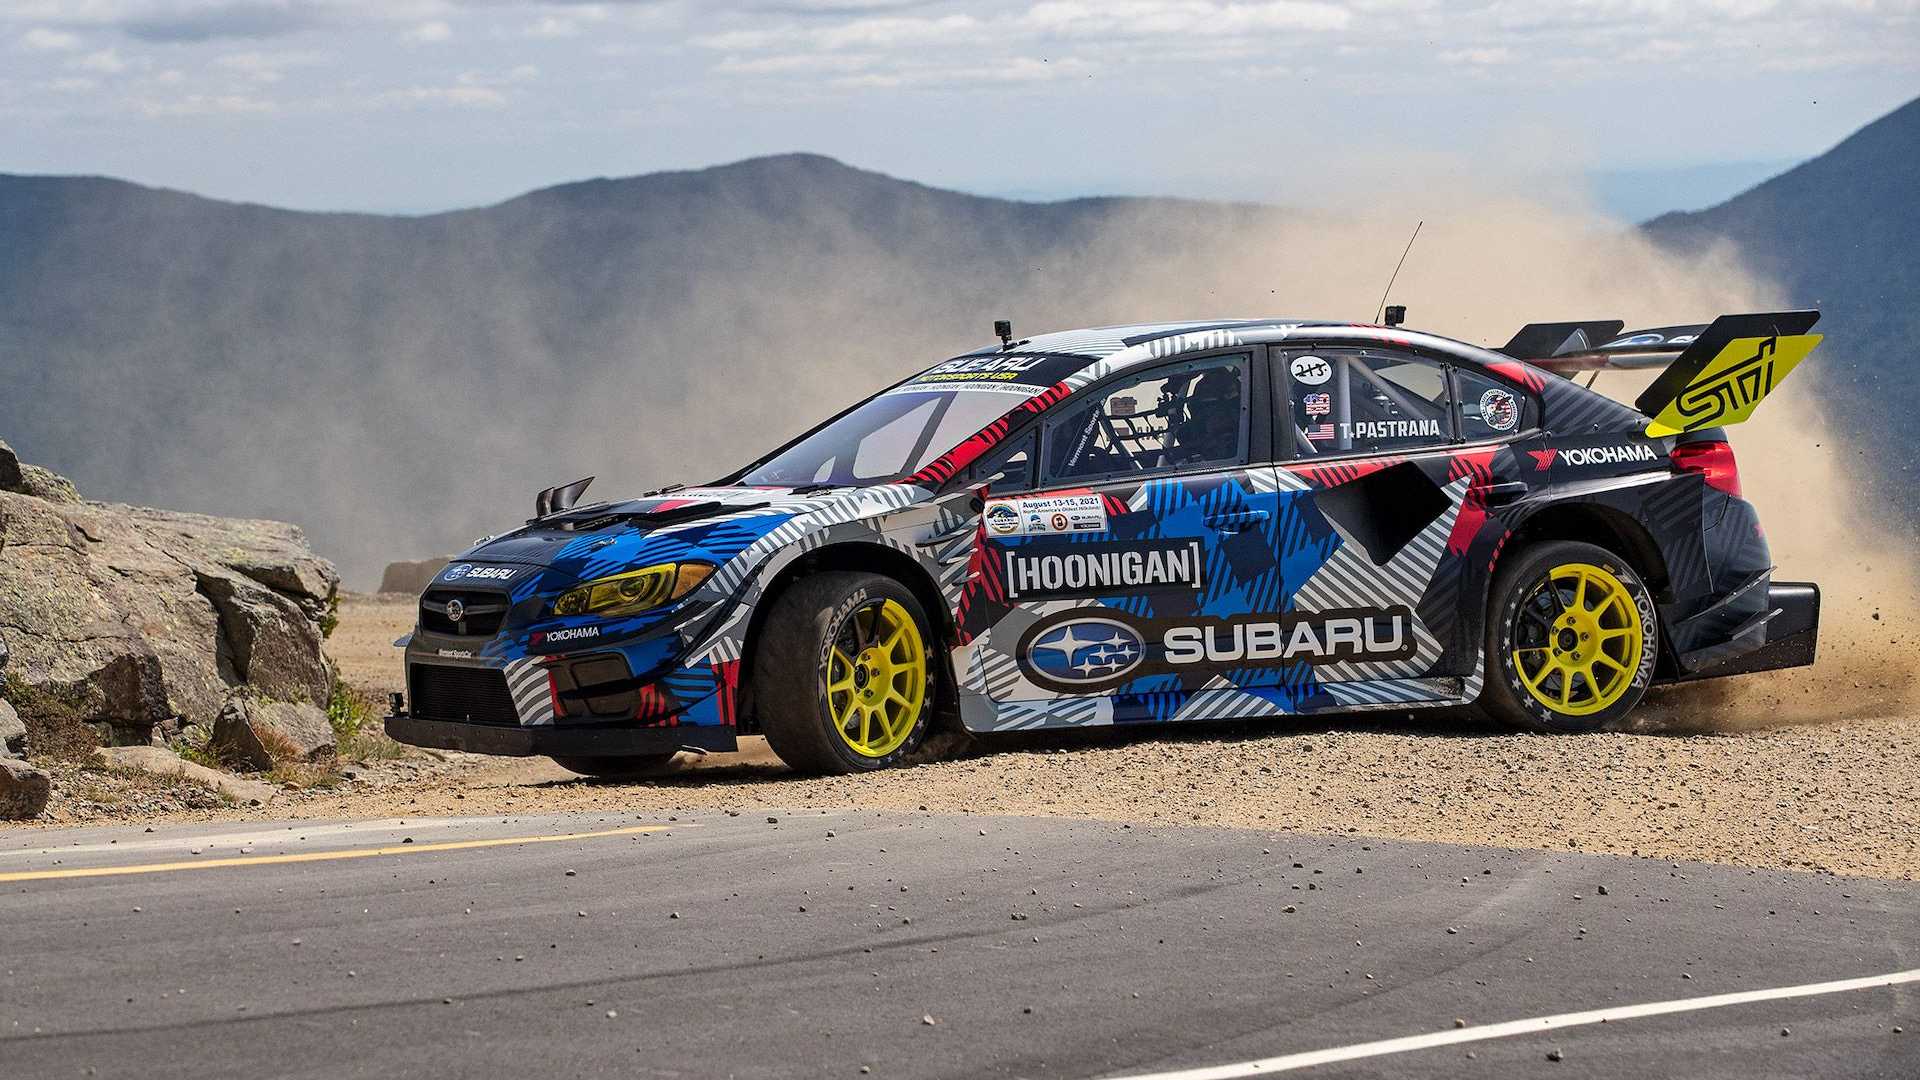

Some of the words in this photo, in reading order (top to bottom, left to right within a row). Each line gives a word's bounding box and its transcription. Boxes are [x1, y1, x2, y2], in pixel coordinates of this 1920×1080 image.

[932, 356, 1047, 374] SUBARU
[1676, 336, 1777, 433] STI
[1067, 434, 1089, 467] Vermont
[1558, 445, 1658, 467] YOKOHAMA
[1022, 498, 1052, 509] August
[1053, 498, 1078, 507] 13-15,
[1079, 497, 1100, 506] 2021
[466, 567, 517, 580] SUBARU
[545, 626, 600, 642] YOKOHAMA
[818, 588, 868, 670] YOKOHAMA
[1163, 615, 1405, 665] SUBARU
[1631, 590, 1655, 688] YOKOHAMA
